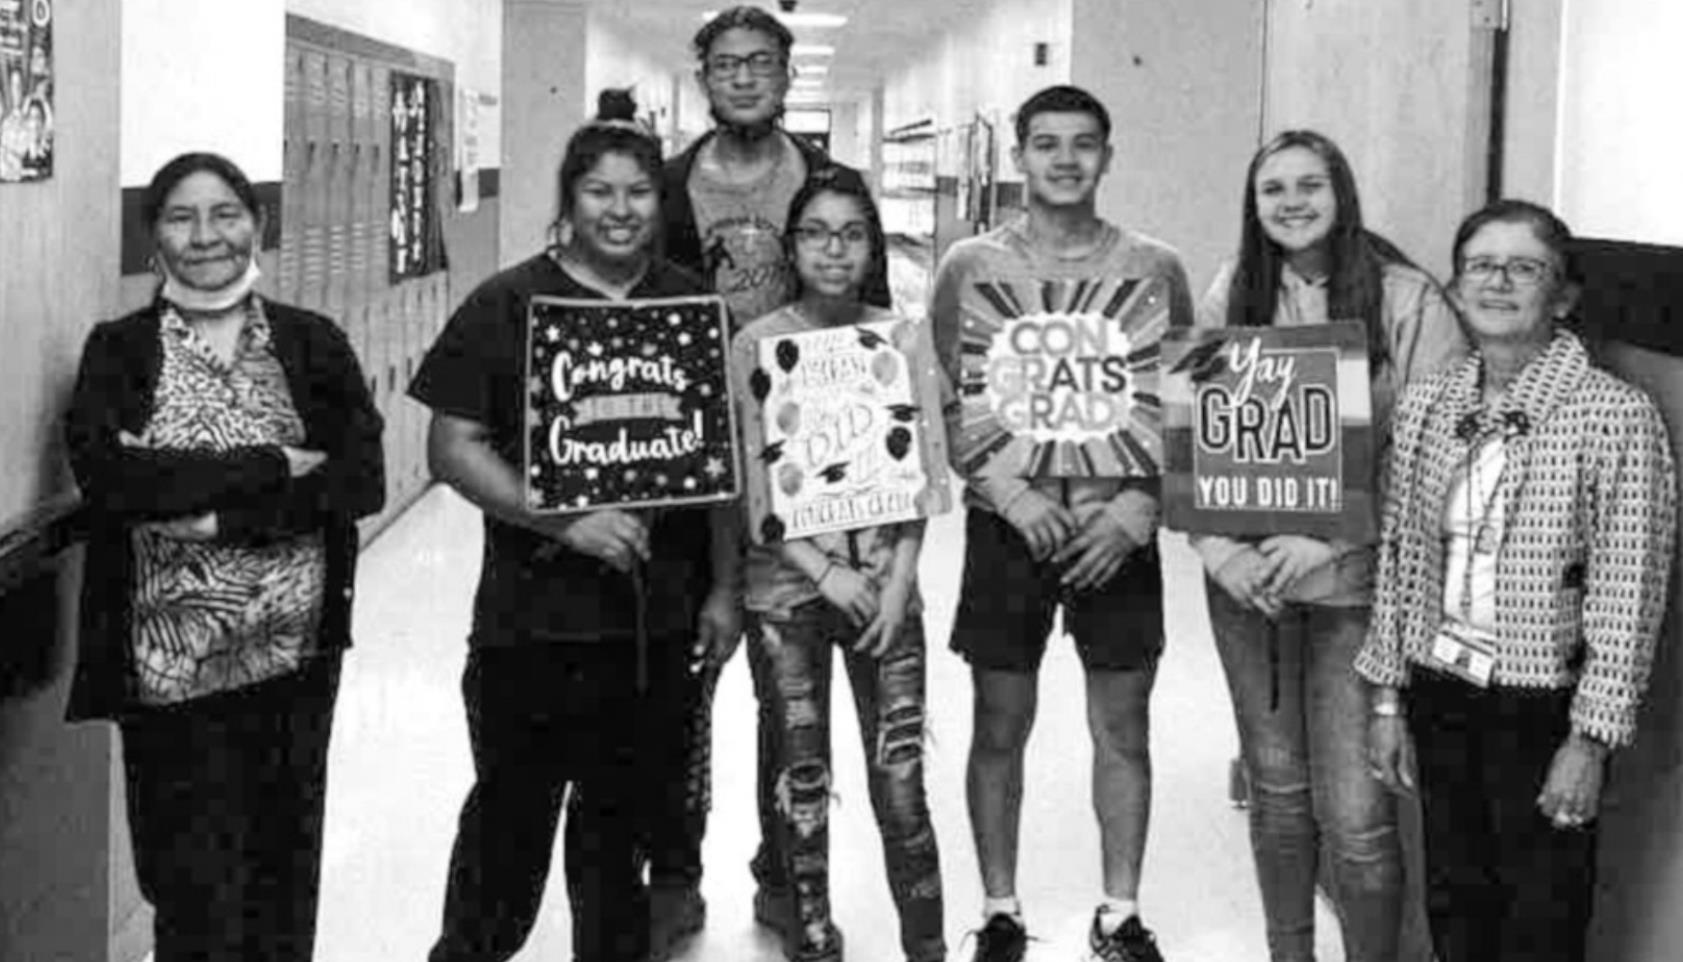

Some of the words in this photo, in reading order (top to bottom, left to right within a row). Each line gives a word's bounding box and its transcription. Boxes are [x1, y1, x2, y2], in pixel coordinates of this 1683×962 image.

[1011, 319, 1107, 355] CON
[553, 351, 689, 402] Congrats
[989, 355, 1126, 395] GRATS
[1229, 336, 1296, 411] Yay
[999, 393, 1112, 431] GRAD
[1198, 383, 1335, 464] GRAD
[550, 409, 704, 465] Graduate!
[1199, 475, 1247, 506] YOU
[1257, 476, 1298, 507] DID
[1307, 477, 1338, 509] IT!
